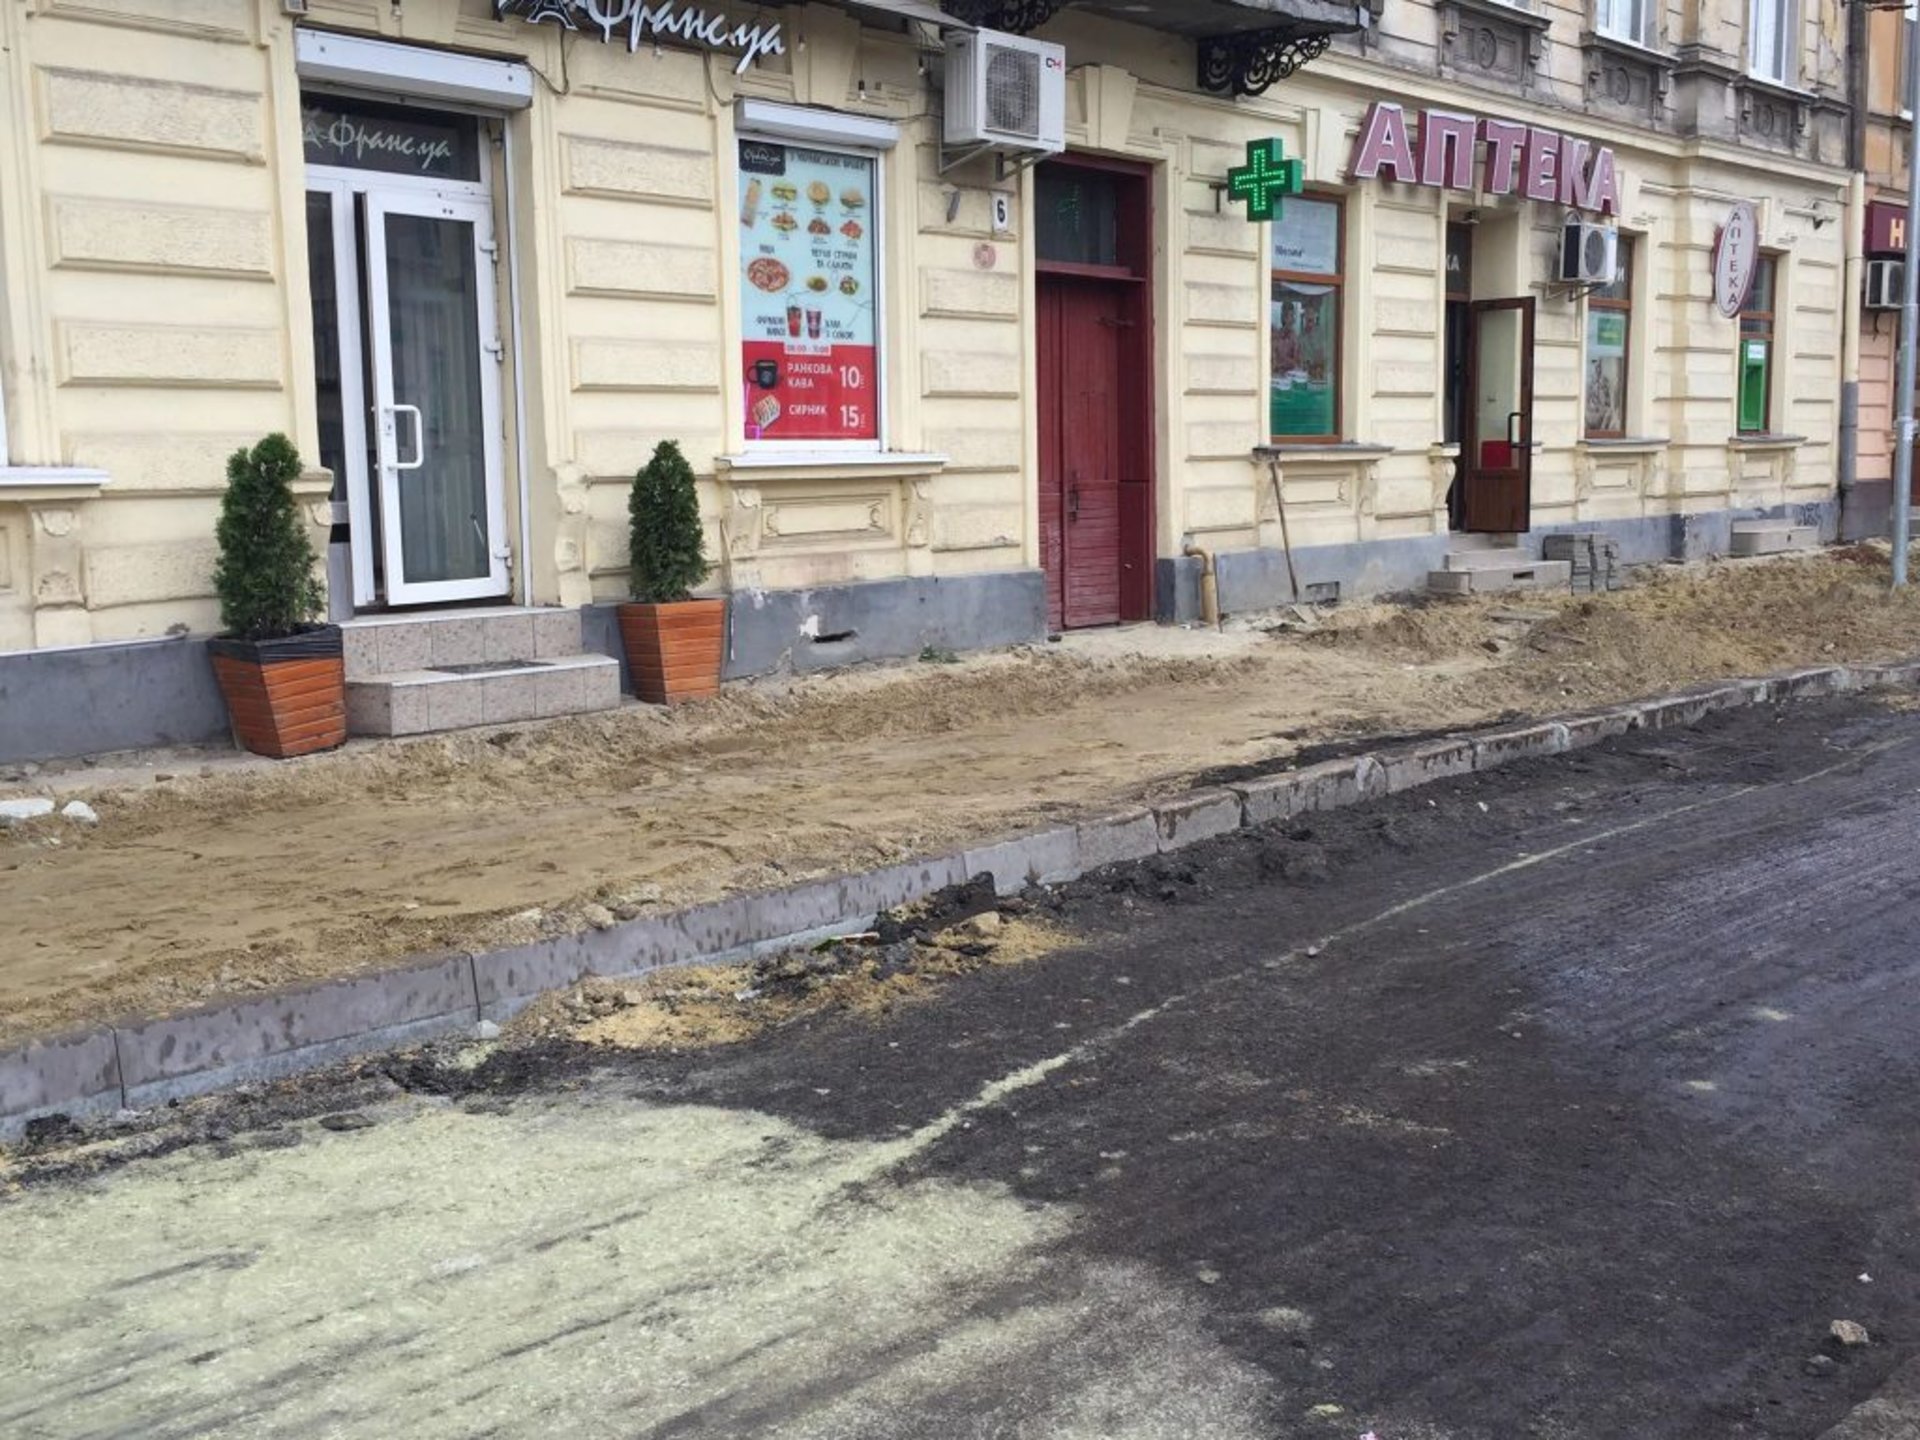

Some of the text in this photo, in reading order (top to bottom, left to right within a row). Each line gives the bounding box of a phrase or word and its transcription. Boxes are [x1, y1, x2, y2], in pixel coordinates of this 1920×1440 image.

[1351, 101, 1621, 217] АПТЕКА
[996, 199, 1006, 224] 6
[1727, 211, 1742, 305] АПТЕКА
[787, 363, 833, 374] РАНКОВА
[840, 365, 860, 388] 10
[788, 377, 814, 388] КАВА
[788, 404, 827, 416] СИРНИК
[840, 404, 860, 428] 15
